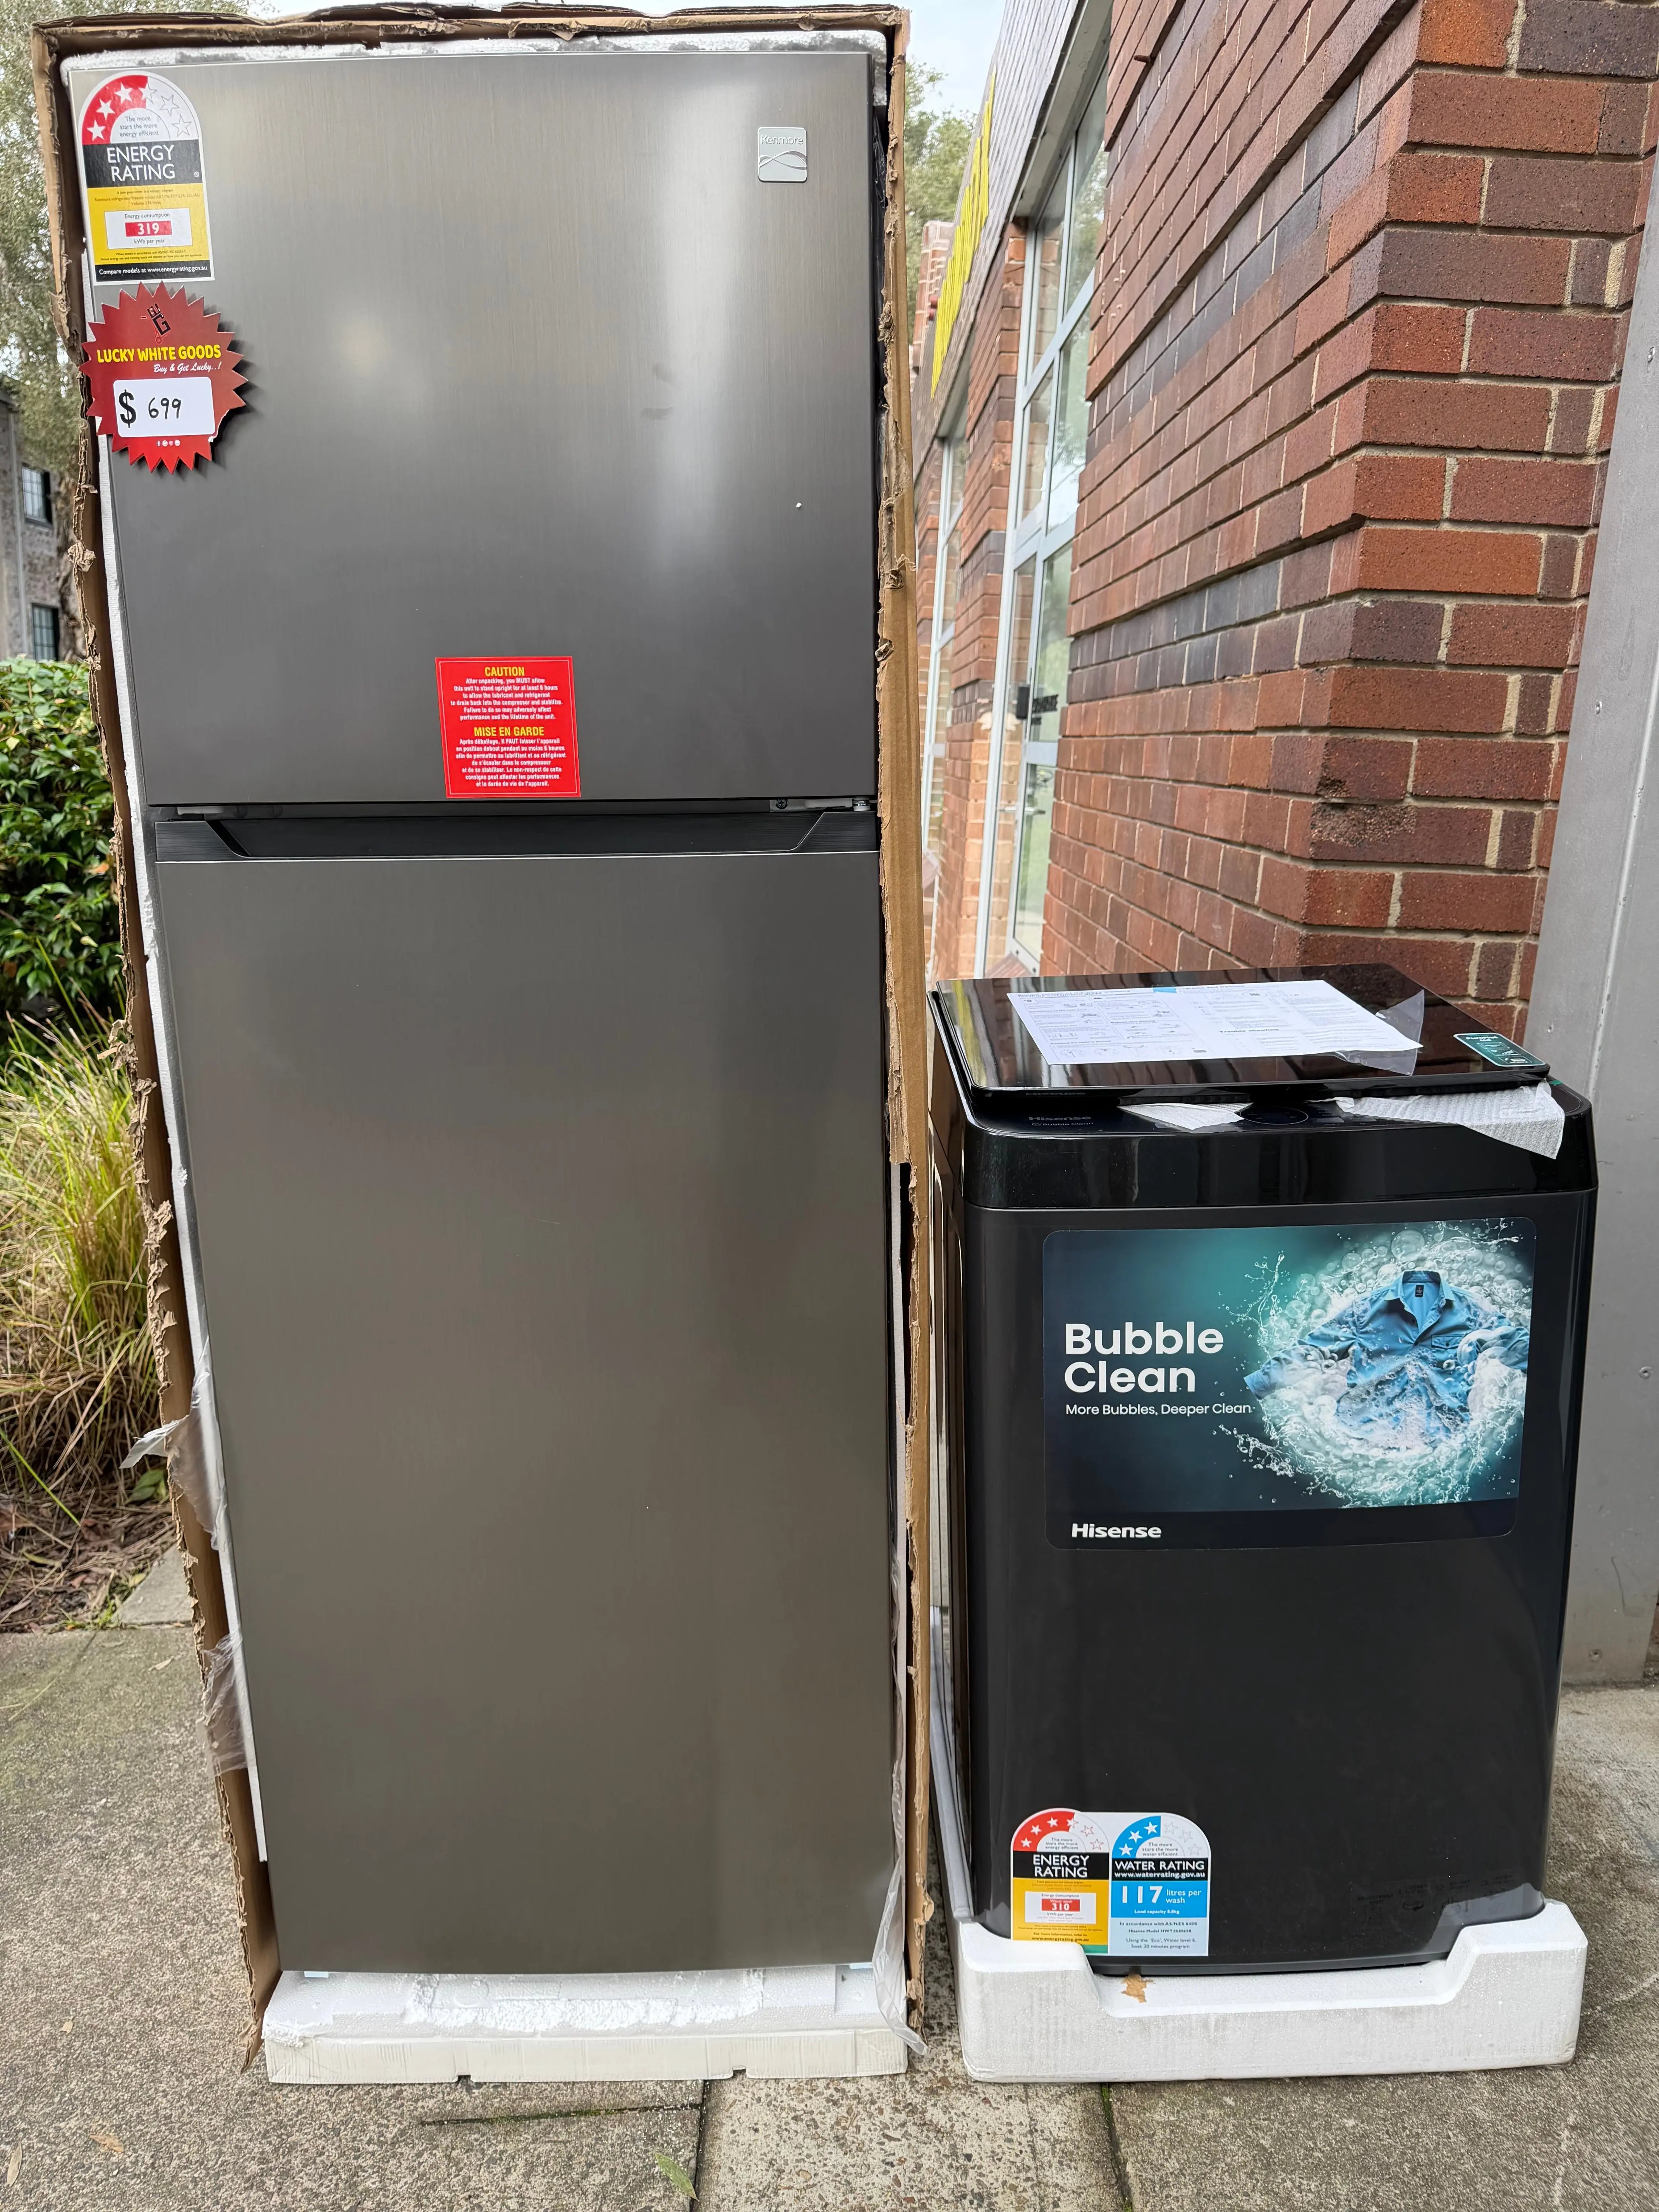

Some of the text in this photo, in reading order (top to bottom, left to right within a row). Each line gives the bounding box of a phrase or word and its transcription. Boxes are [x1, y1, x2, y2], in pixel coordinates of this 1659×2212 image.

[760, 135, 803, 144] Kenmore
[107, 144, 174, 163] ENERGY
[111, 163, 175, 182] RATING
[138, 223, 159, 235] 319
[97, 345, 221, 363] LUCKY WHITE GOODS
[153, 364, 167, 374] Buy
[170, 362, 175, 372] &
[177, 362, 189, 372] Get
[148, 397, 181, 420] 699
[484, 666, 525, 677] CAUTION
[474, 726, 544, 737] MISE EN GARDE
[1065, 1321, 1224, 1355] Bubble
[1064, 1360, 1195, 1393] Clean
[1066, 1404, 1099, 1415] More
[1103, 1404, 1158, 1416] Bubbles,
[1161, 1404, 1210, 1417] Deeper
[1071, 1523, 1162, 1538] Hisense
[1033, 1854, 1089, 1866] ENERGY
[1115, 1860, 1205, 1870] WATER RATING
[1034, 1866, 1087, 1878] RATING
[1122, 1886, 1163, 1904] 117
[1166, 1888, 1186, 1896] litres
